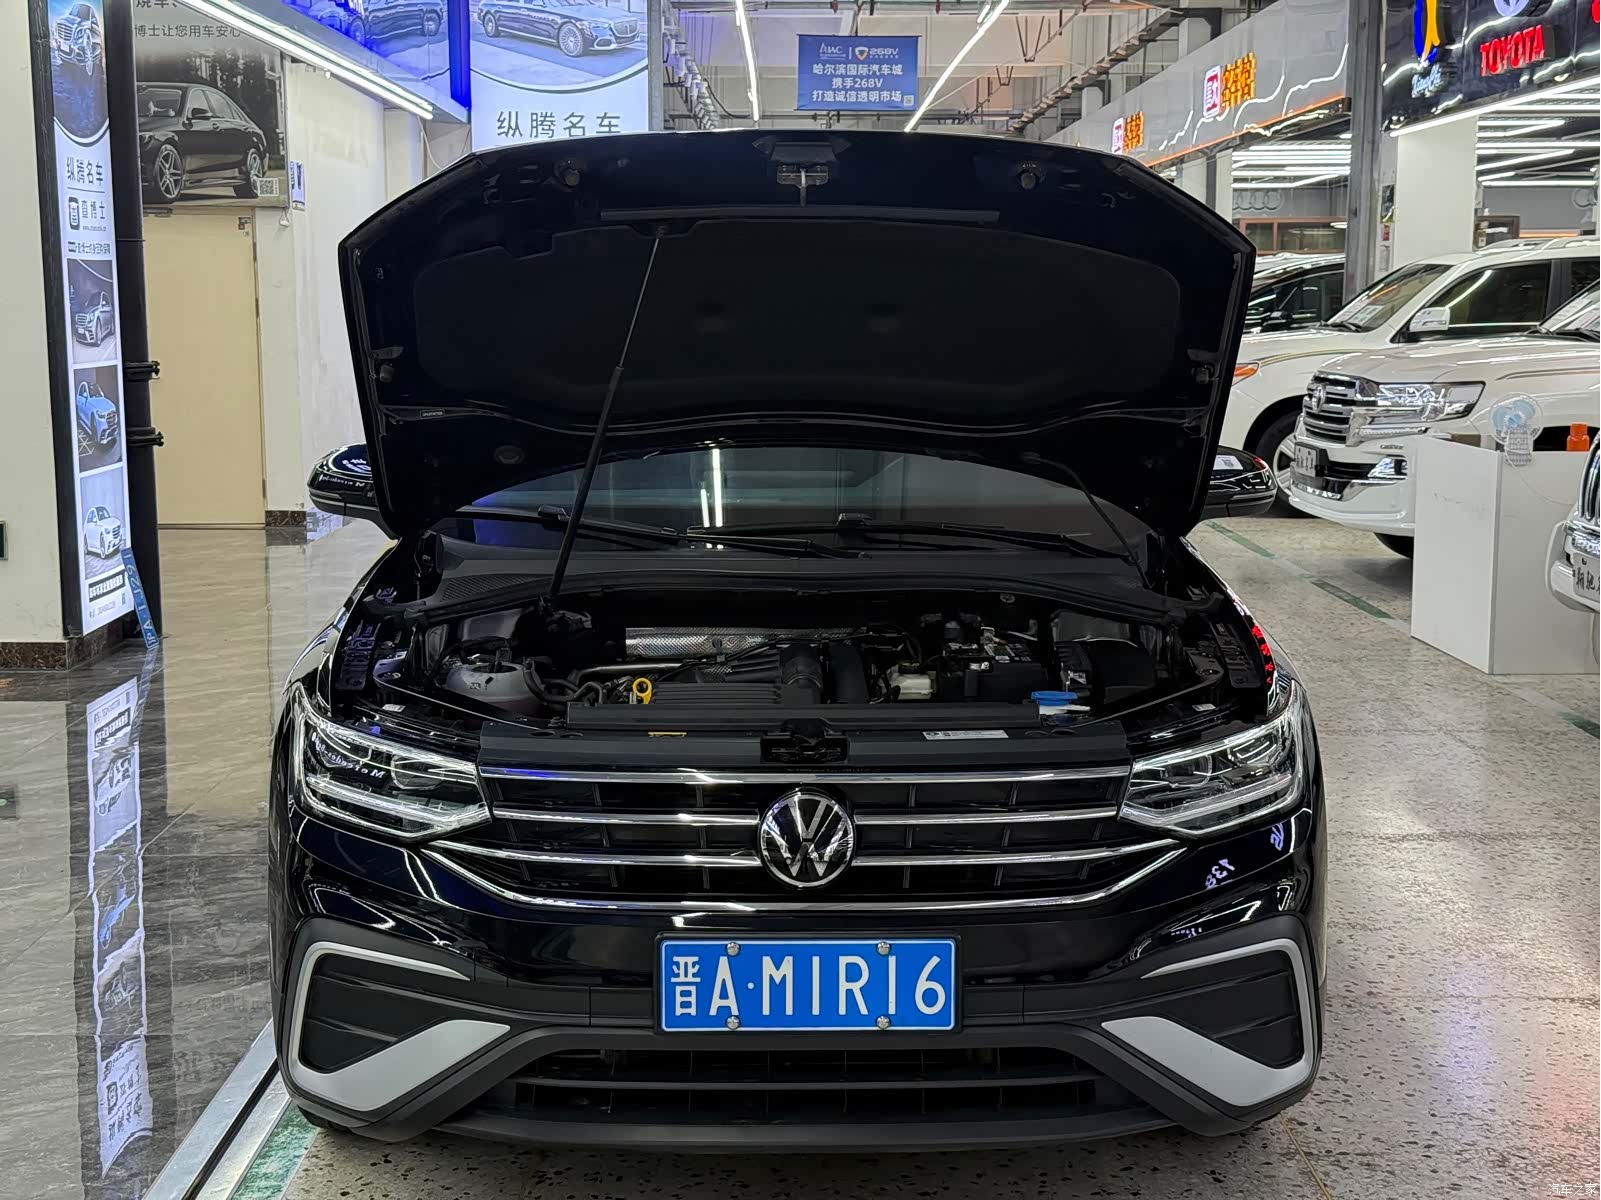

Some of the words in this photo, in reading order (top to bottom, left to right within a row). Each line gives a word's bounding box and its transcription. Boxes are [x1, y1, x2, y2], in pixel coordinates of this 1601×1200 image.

[1480, 25, 1545, 77] TOYOTA
[812, 64, 903, 76] 哈尔滨国际汽车城
[832, 78, 884, 89] 携手268V
[812, 90, 902, 102] 打造诚信透明市场
[496, 111, 622, 139] 纵腾名车
